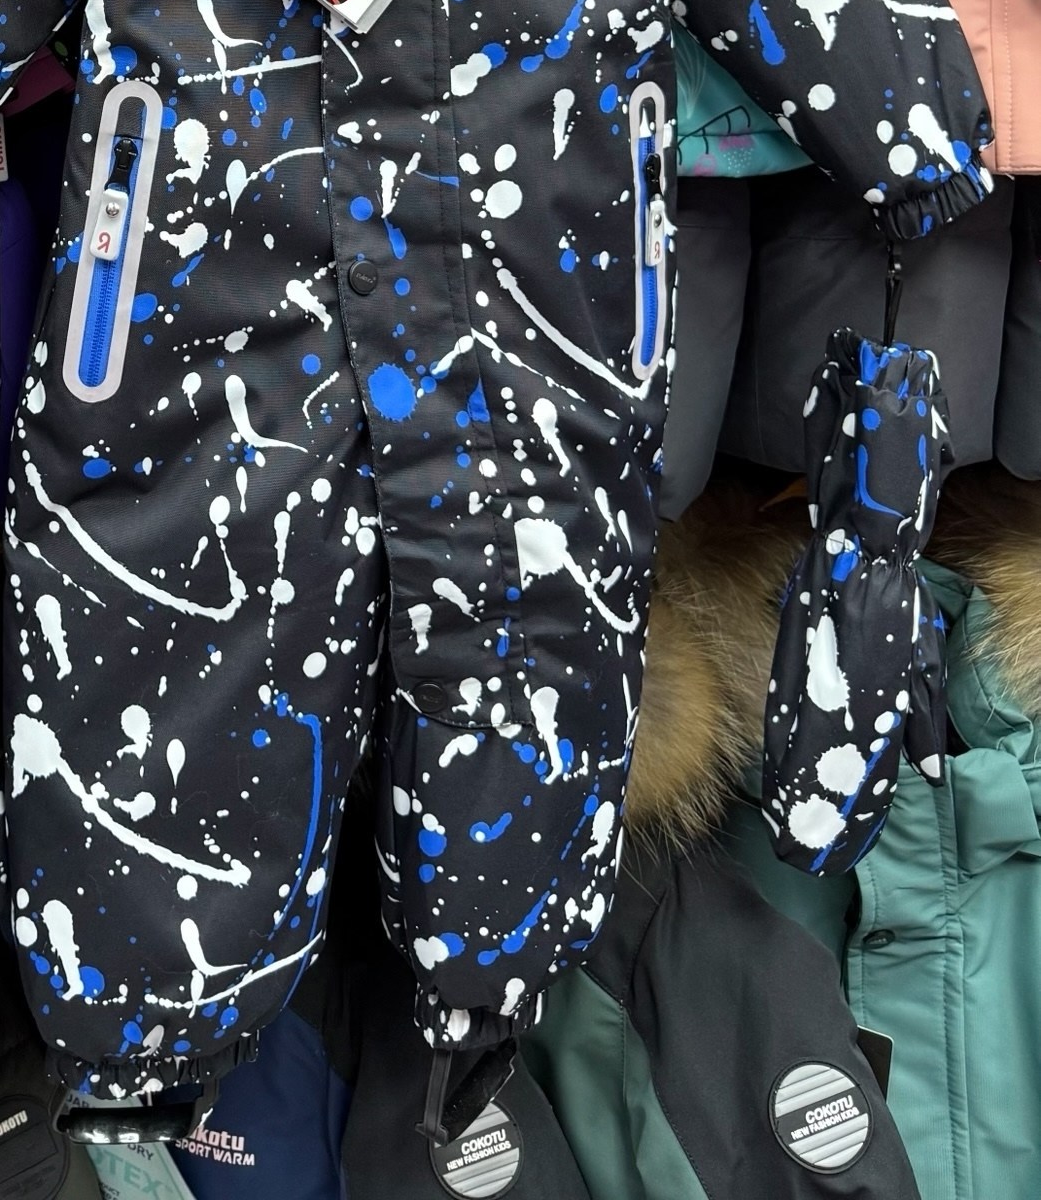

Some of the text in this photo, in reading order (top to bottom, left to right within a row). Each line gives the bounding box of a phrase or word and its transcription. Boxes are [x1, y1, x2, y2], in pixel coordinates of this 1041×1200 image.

[790, 1107, 860, 1140] NEW FASHION KIDS
[805, 1095, 854, 1124] COKOTU
[175, 1138, 255, 1166] SPORT WARM
[446, 1140, 512, 1171] NEW FASHION KIDS
[461, 1128, 506, 1155] COKOTU
